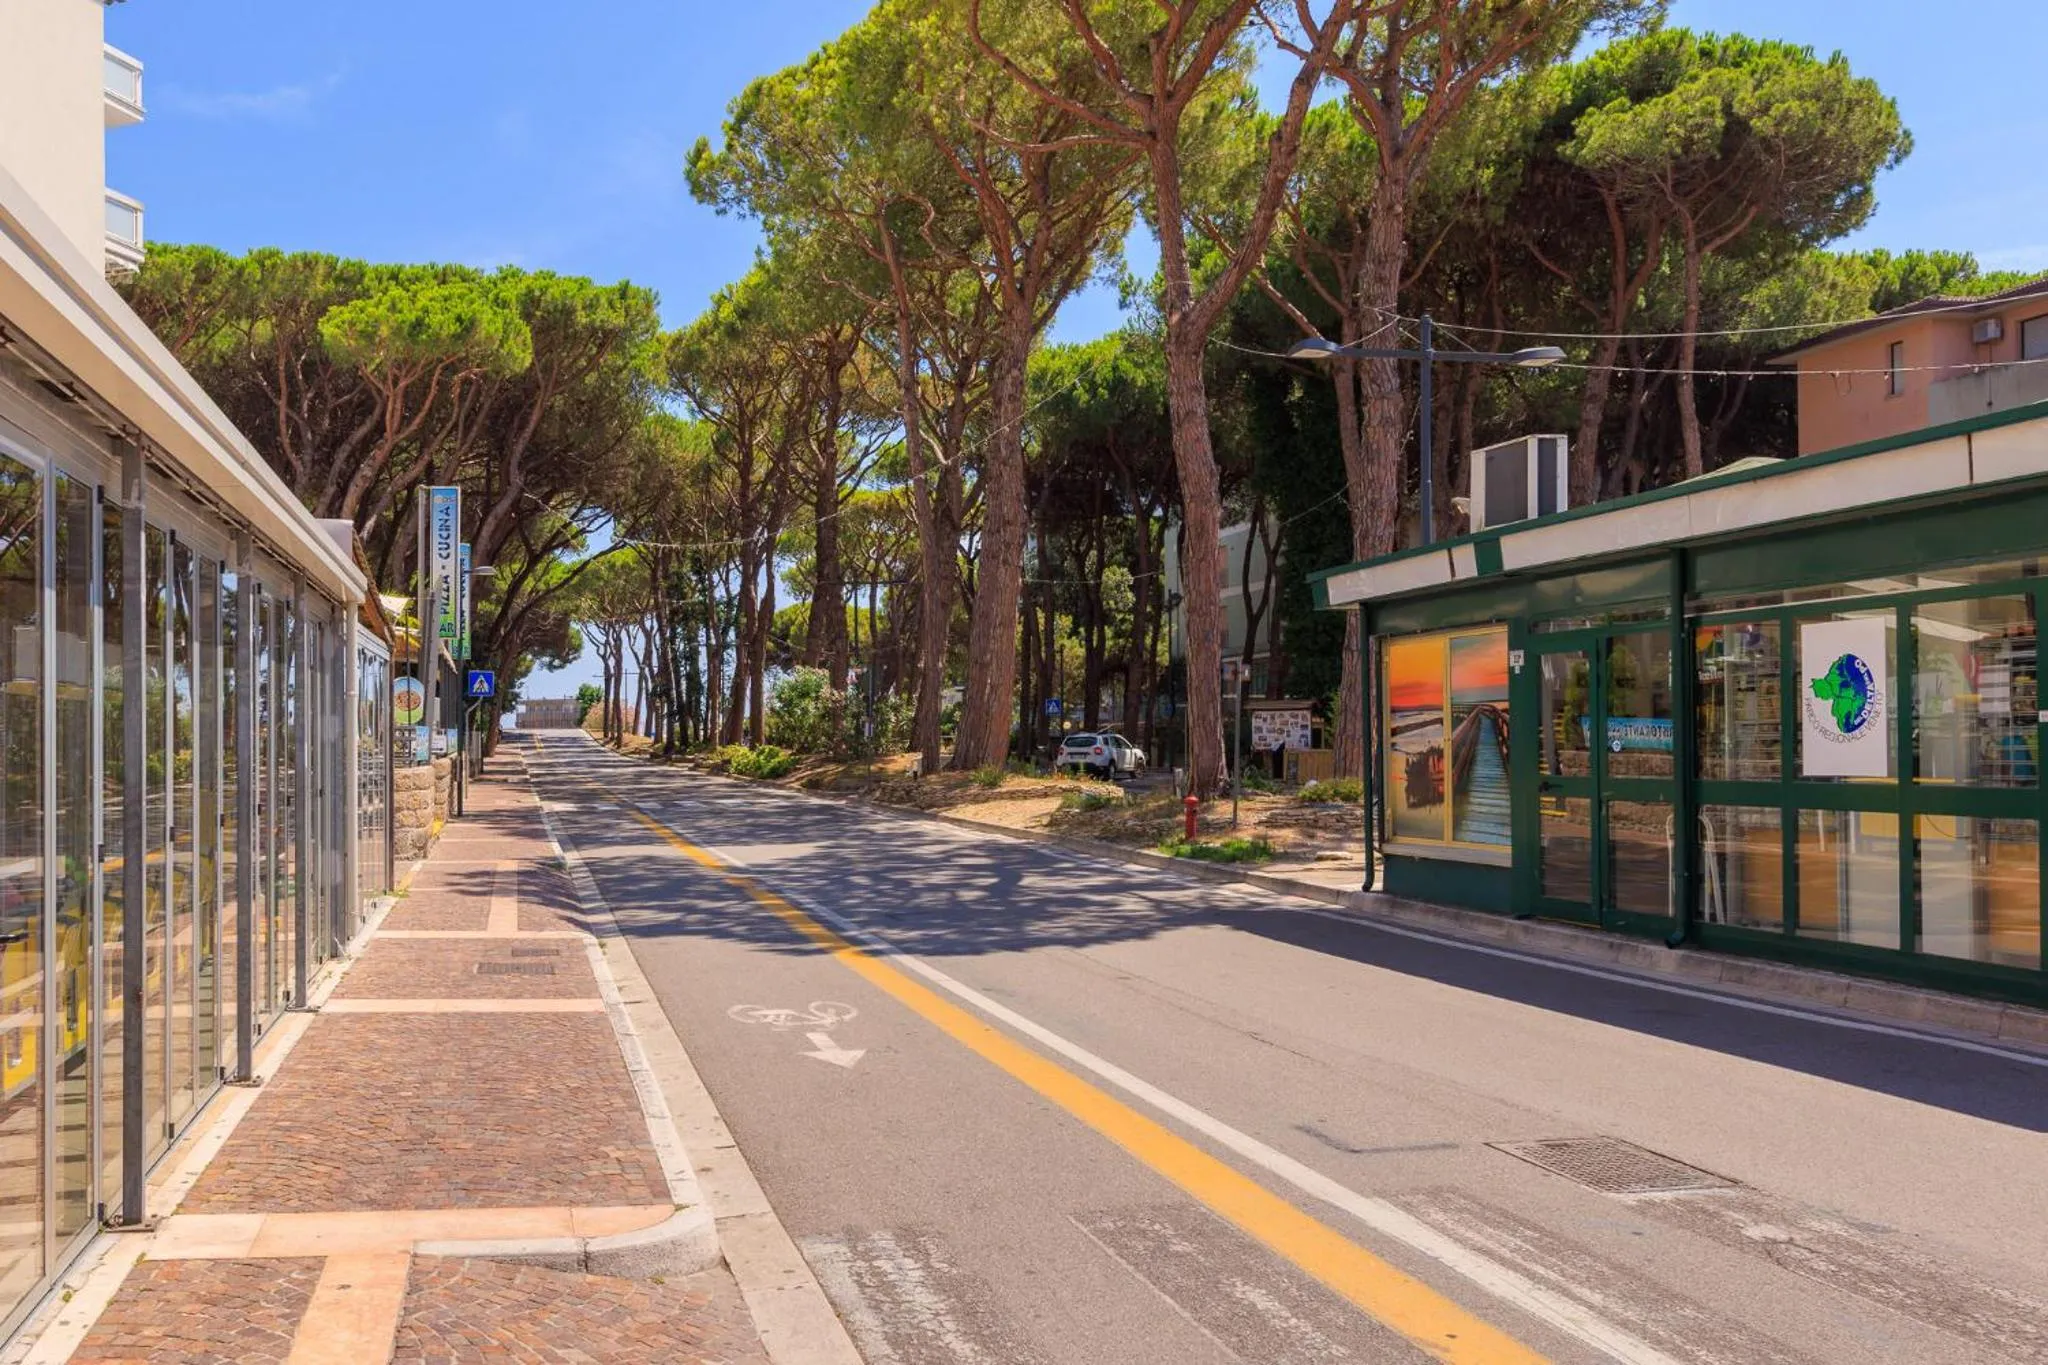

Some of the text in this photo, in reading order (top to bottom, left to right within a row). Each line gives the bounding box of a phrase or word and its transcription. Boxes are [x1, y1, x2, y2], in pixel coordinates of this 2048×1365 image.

[438, 506, 450, 560] CUCINA
[440, 574, 450, 615] PIZZA
[439, 622, 454, 633] AR
[1861, 683, 1874, 719] DELTA
[1819, 727, 1866, 743] REGIONALE
